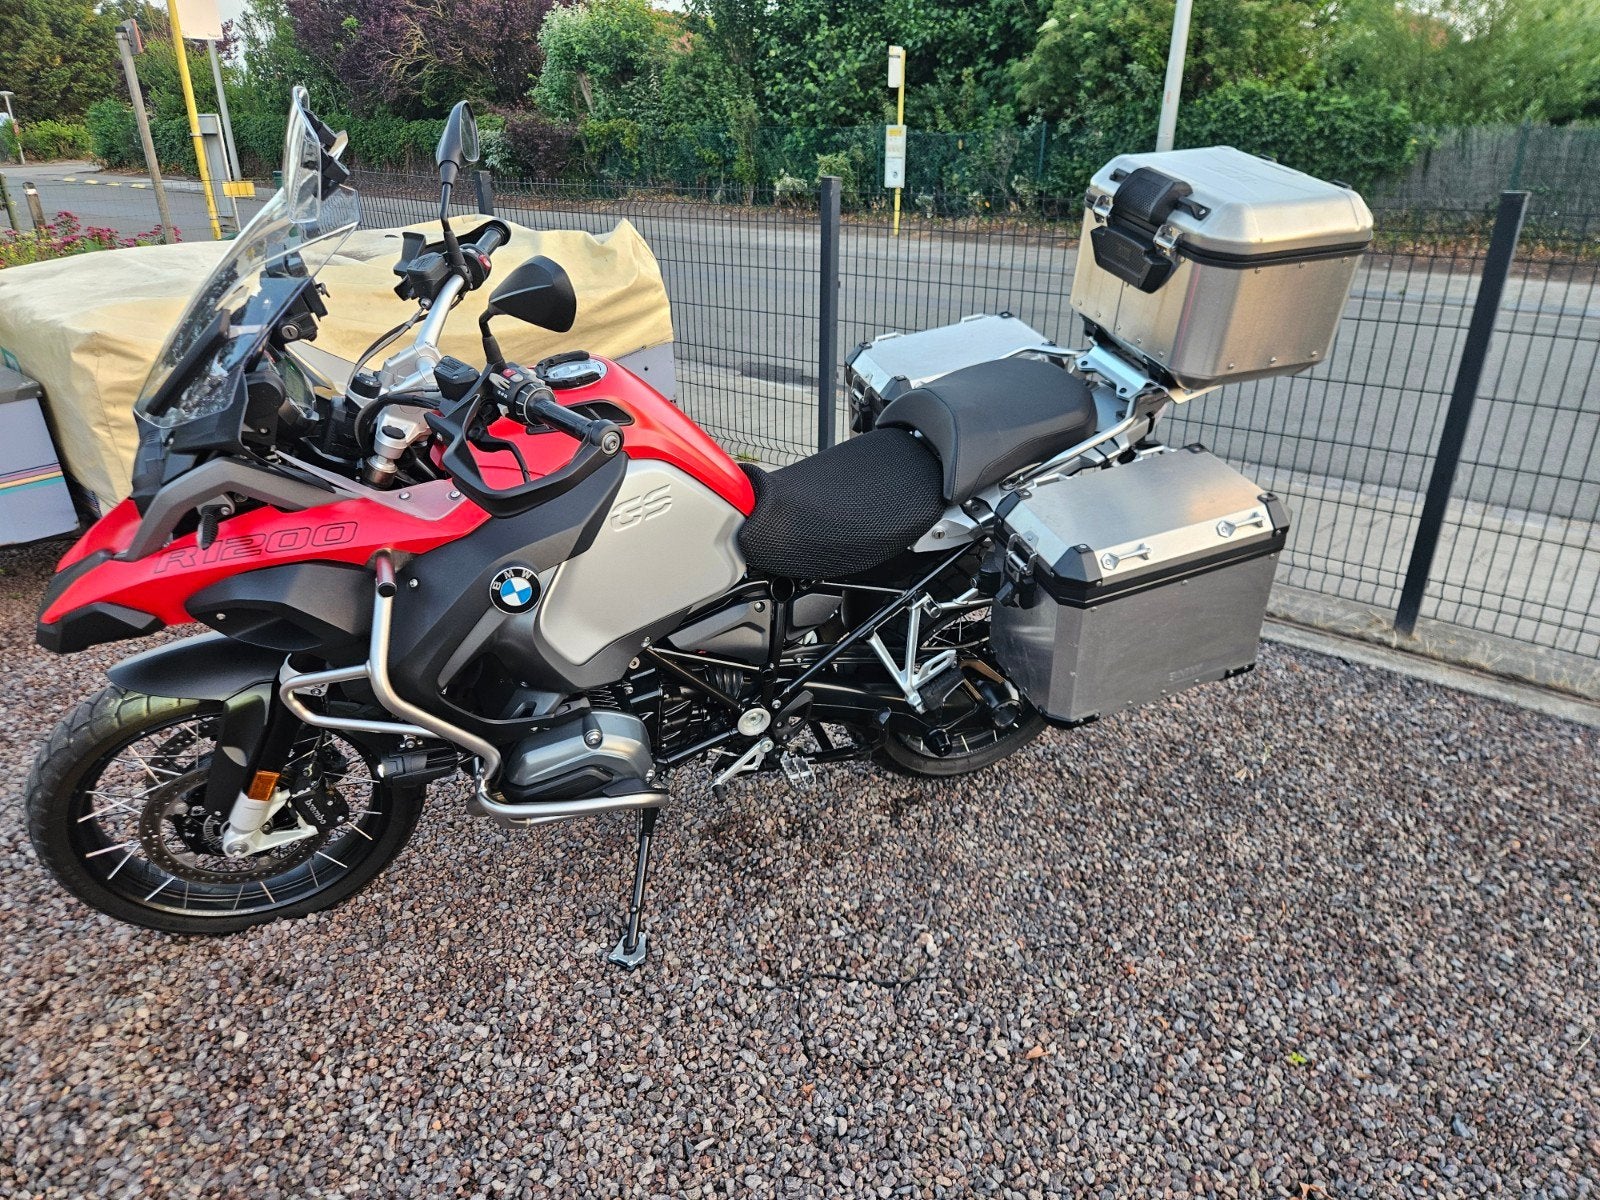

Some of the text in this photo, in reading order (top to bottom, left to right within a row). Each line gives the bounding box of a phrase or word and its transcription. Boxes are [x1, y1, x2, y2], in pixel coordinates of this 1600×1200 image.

[610, 483, 672, 533] GS
[154, 521, 358, 574] R1200
[491, 569, 532, 591] BMW
[304, 798, 327, 825] brembo
